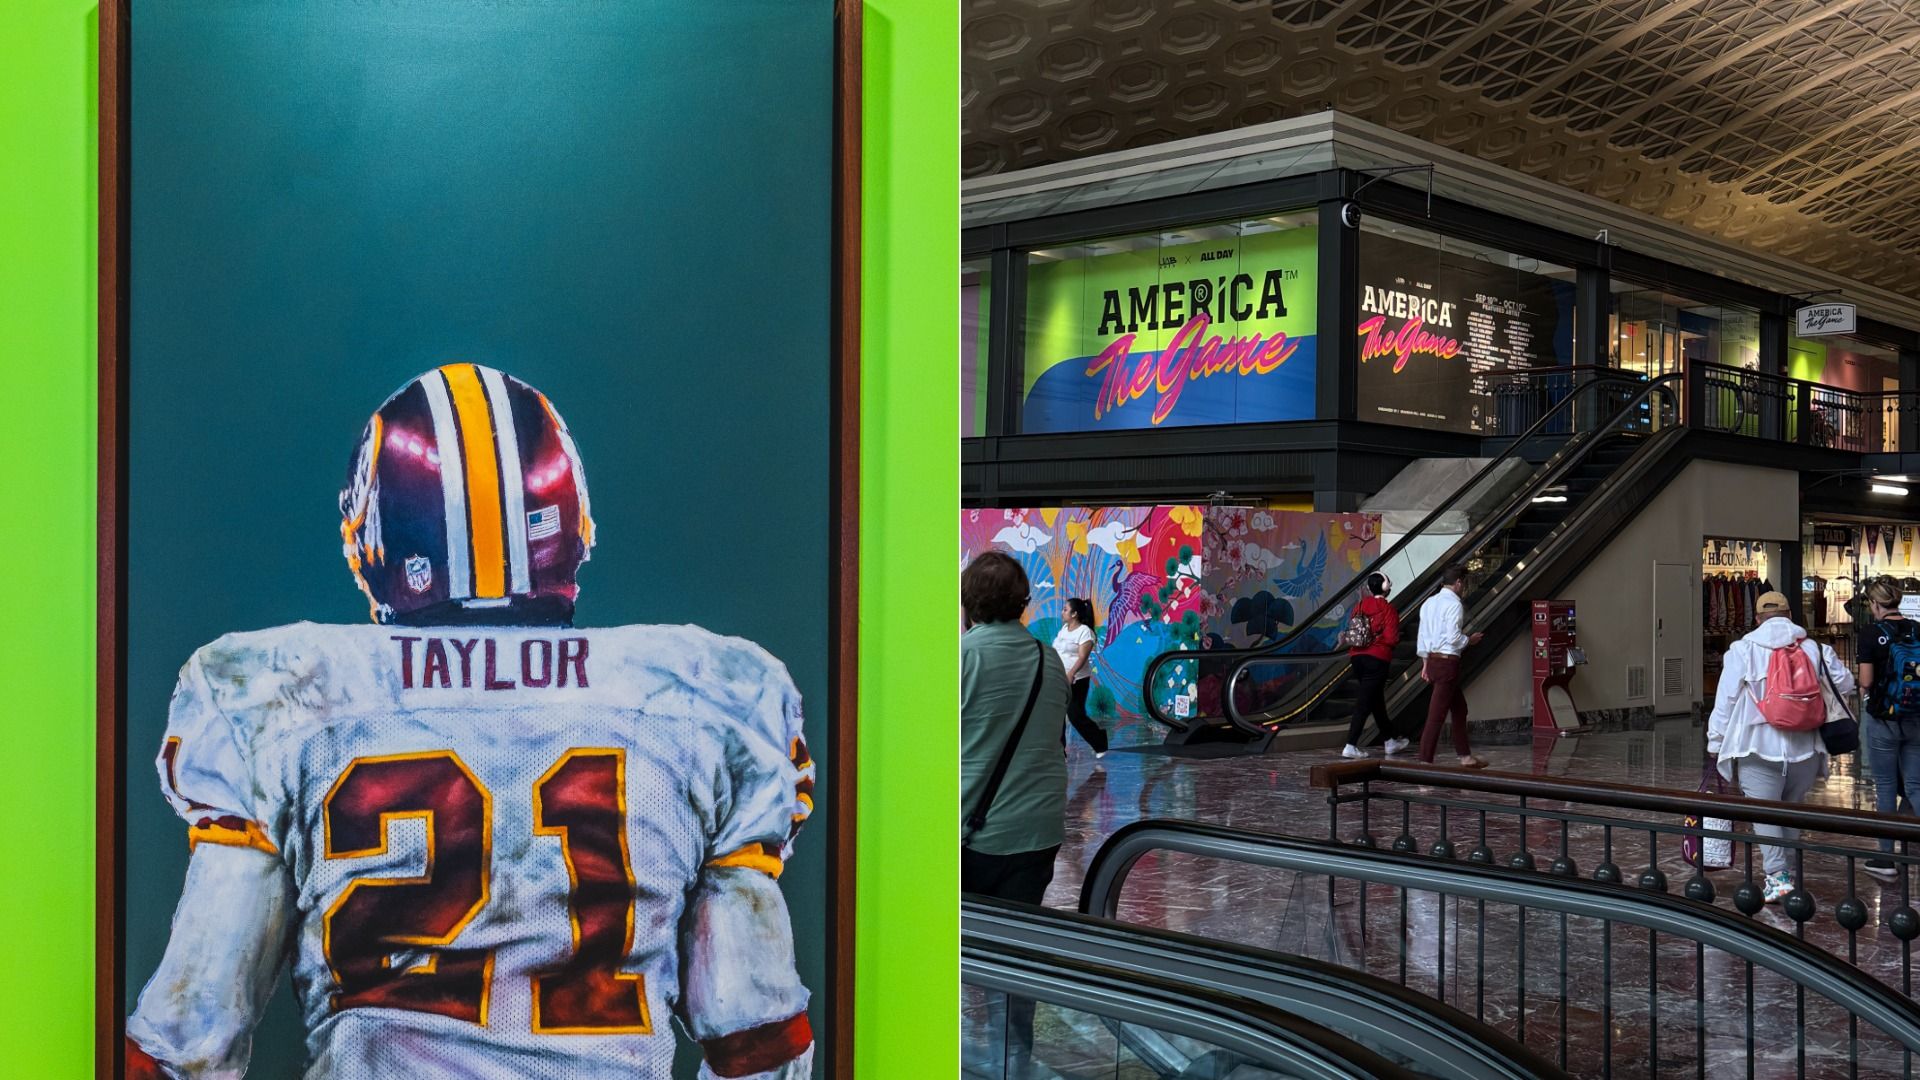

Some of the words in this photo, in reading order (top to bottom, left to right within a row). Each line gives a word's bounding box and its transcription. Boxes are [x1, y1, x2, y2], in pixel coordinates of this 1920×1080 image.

[1200, 251, 1215, 262] ALL
[1216, 249, 1234, 260] DAY
[1085, 333, 1157, 422] The
[1152, 313, 1301, 425] Game
[1358, 315, 1395, 363] The
[1392, 315, 1463, 374] Game
[1708, 552, 1734, 566] HBCU
[1823, 529, 1846, 543] YARD
[390, 635, 590, 691] TAYLOR
[322, 747, 654, 1035] 21
